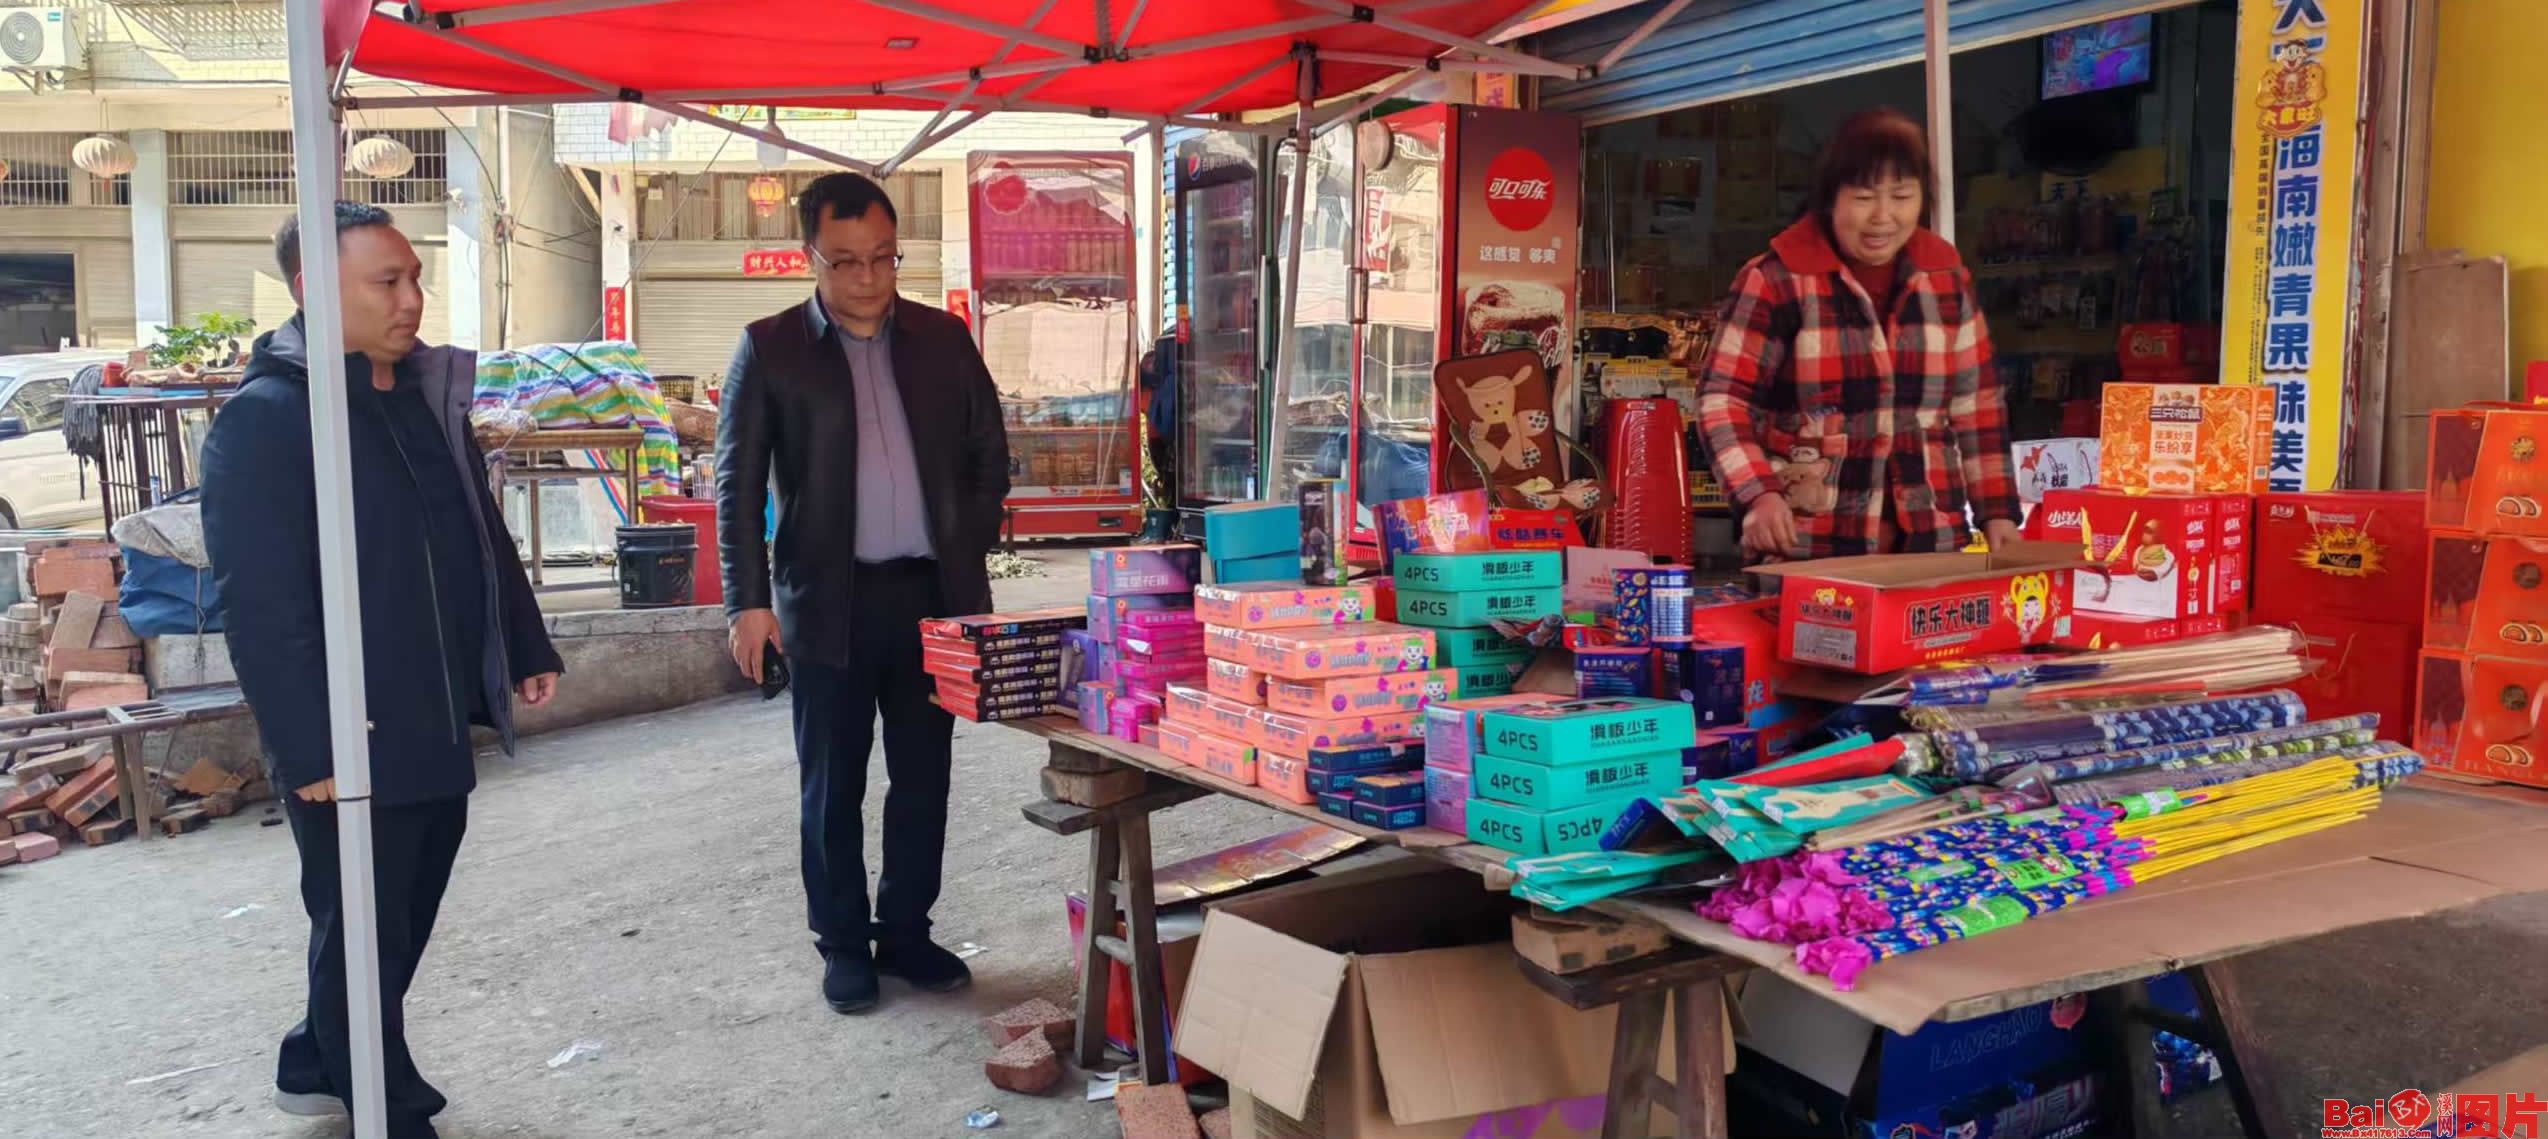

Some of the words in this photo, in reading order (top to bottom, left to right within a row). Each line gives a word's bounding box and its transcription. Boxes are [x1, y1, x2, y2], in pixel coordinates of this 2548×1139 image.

[1404, 566, 1439, 582] 4PCS
[1409, 599, 1447, 616] 4PCS
[1498, 727, 1538, 752] 4PCS
[1490, 772, 1534, 796] 4PCS
[1479, 818, 1523, 844] 4PCS
[1557, 817, 1603, 842] 4PCS
